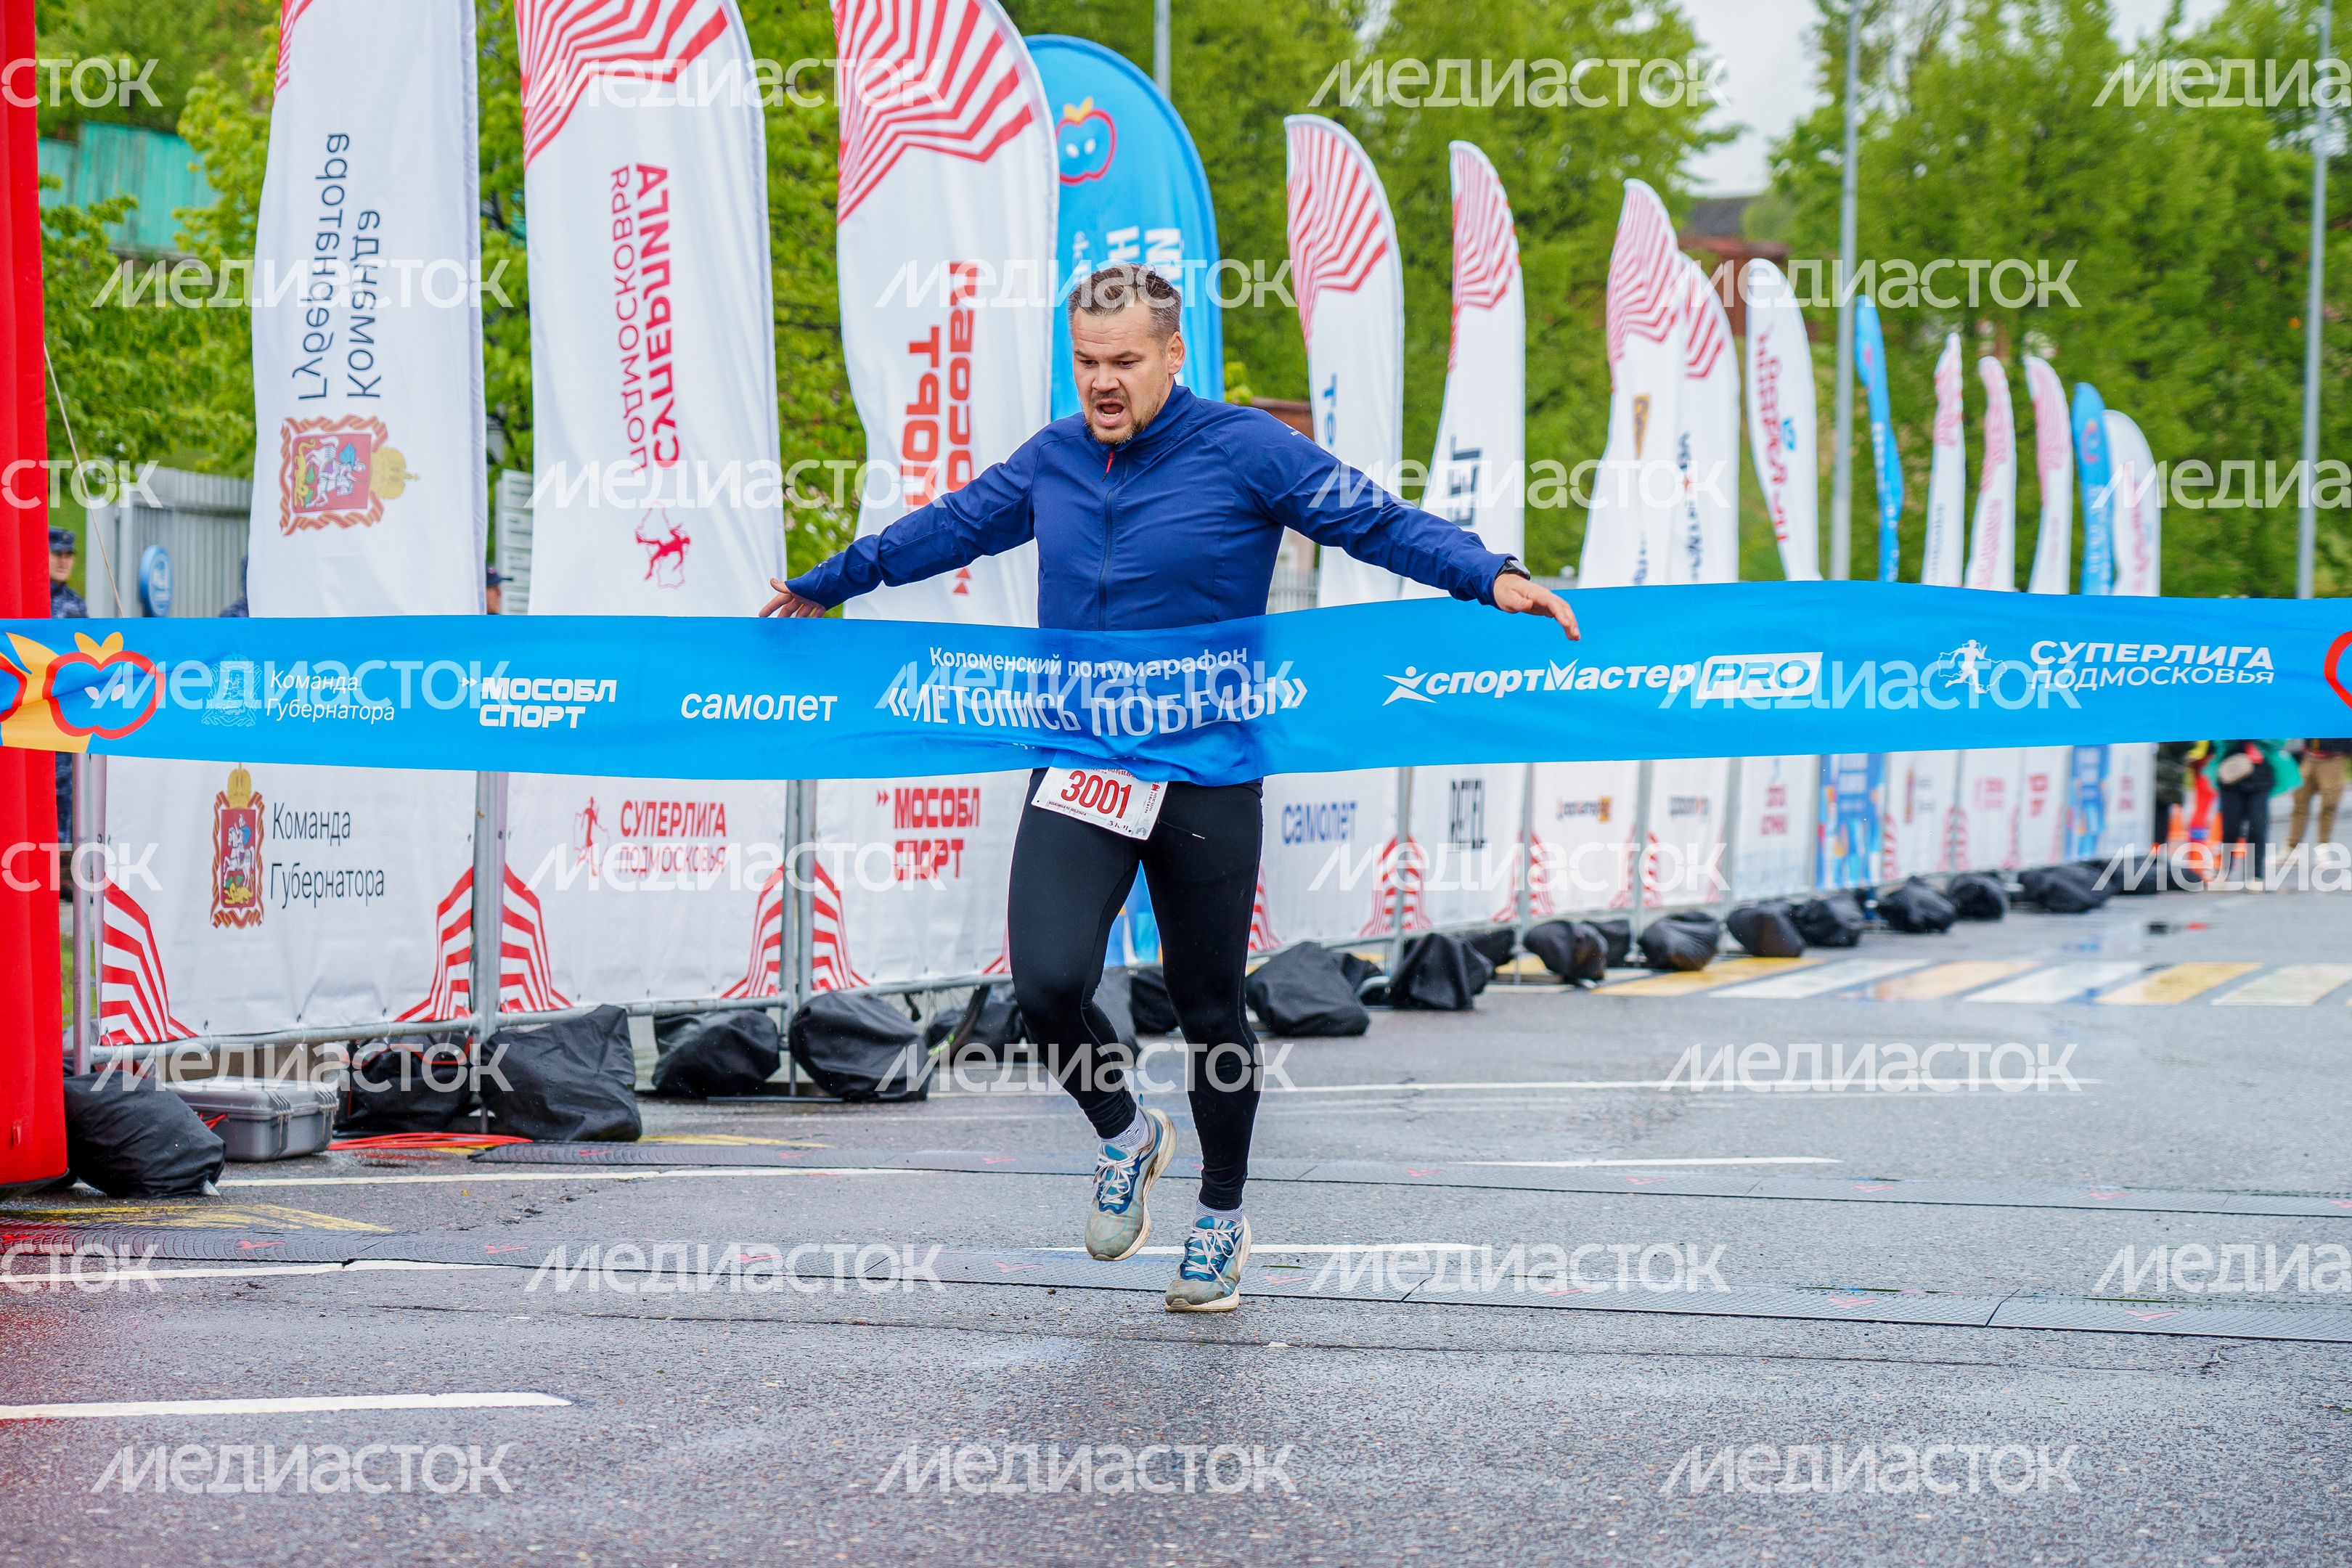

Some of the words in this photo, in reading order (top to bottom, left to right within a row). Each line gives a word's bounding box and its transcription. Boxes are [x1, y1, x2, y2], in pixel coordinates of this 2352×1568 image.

[930, 647, 1061, 675] Коломенский
[1069, 648, 1247, 683] полумарафон
[2030, 640, 2274, 669] СУПЕРЛИГА
[270, 670, 359, 693] Команда
[481, 677, 617, 703] МОСОБЛ
[2030, 666, 2274, 692] ПОДМОСКОВЬЯ
[266, 698, 395, 723] Губернатора
[479, 704, 586, 729] СПОРТ
[681, 693, 838, 722] самолет
[894, 787, 981, 830] МОСОБЛ
[1061, 770, 1132, 819] 3001
[271, 802, 352, 846] Команда
[620, 801, 727, 838] СУПЕРЛИГА
[1282, 801, 1357, 845] самолет
[618, 845, 726, 874] ПОДМОСКОВЬЯ
[893, 838, 963, 881] СПОРТ
[270, 862, 385, 910] Губернатора
